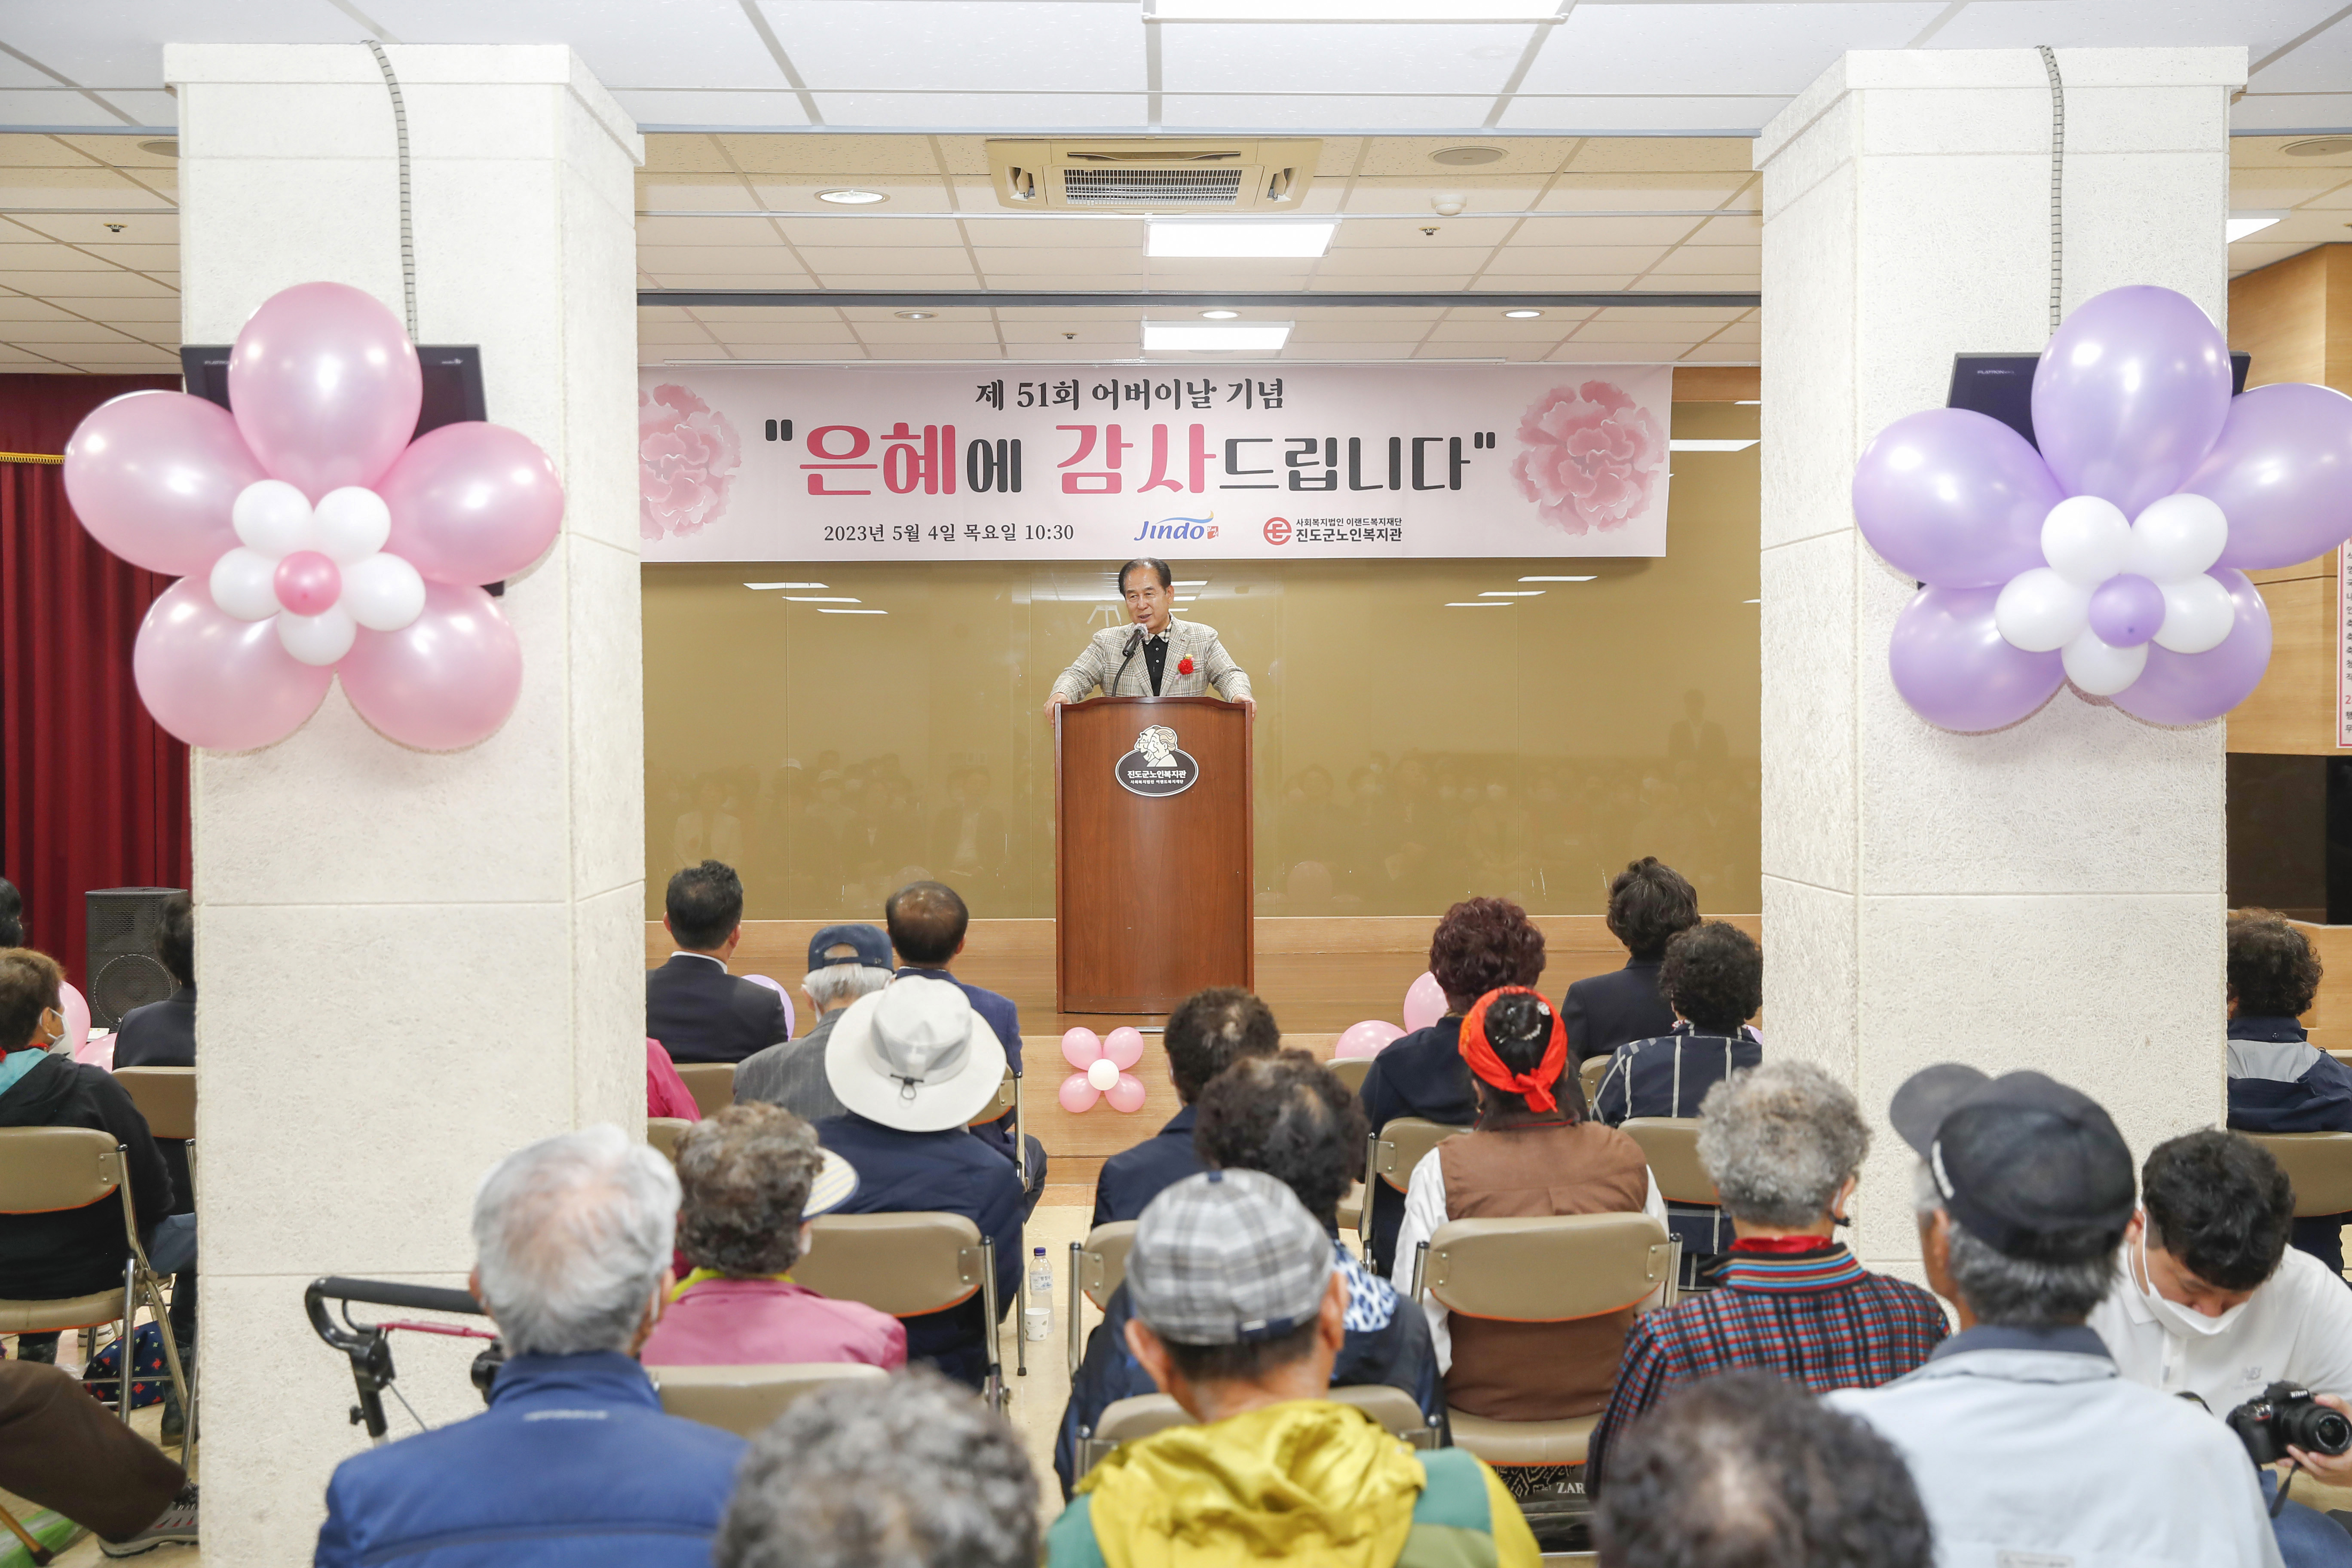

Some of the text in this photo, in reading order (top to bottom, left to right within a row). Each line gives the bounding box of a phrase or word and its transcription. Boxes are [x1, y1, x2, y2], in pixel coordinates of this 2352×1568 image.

[975, 378, 1283, 410] 제 51회 어버이날 기념
[1296, 518, 1402, 527] 사회복지법인 이랜드복지재단
[824, 523, 1074, 542] 2023년 5월 4일 목요일 10:30
[1133, 521, 1204, 541] Jindo
[1296, 527, 1403, 542] 진도군노인복지관
[1127, 770, 1187, 778] 진도군노인복지관
[2290, 1390, 2308, 1399] Nikon
[1556, 1482, 1586, 1494] ZAR
